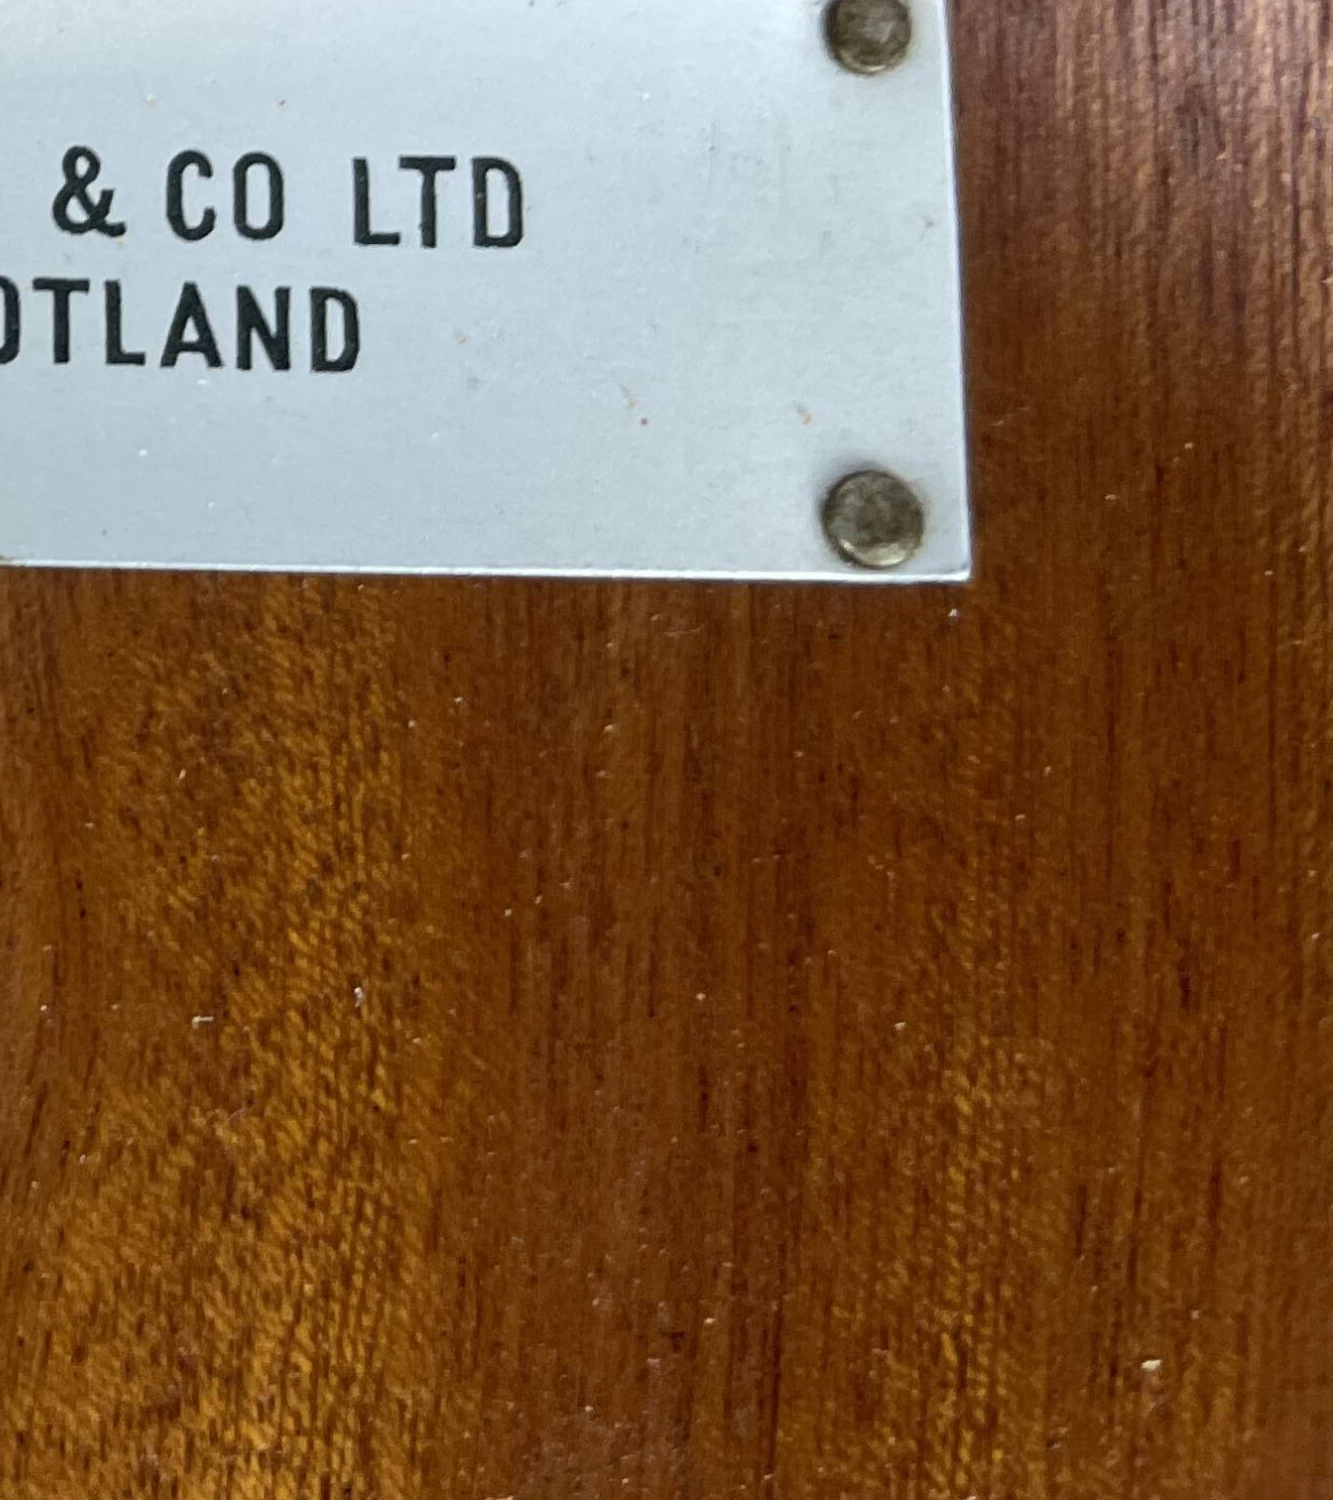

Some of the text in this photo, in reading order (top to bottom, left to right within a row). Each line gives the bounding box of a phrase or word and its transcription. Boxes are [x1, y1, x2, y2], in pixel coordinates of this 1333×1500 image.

[52, 146, 127, 239] &
[167, 150, 284, 242] CO
[353, 156, 524, 249] LTD
